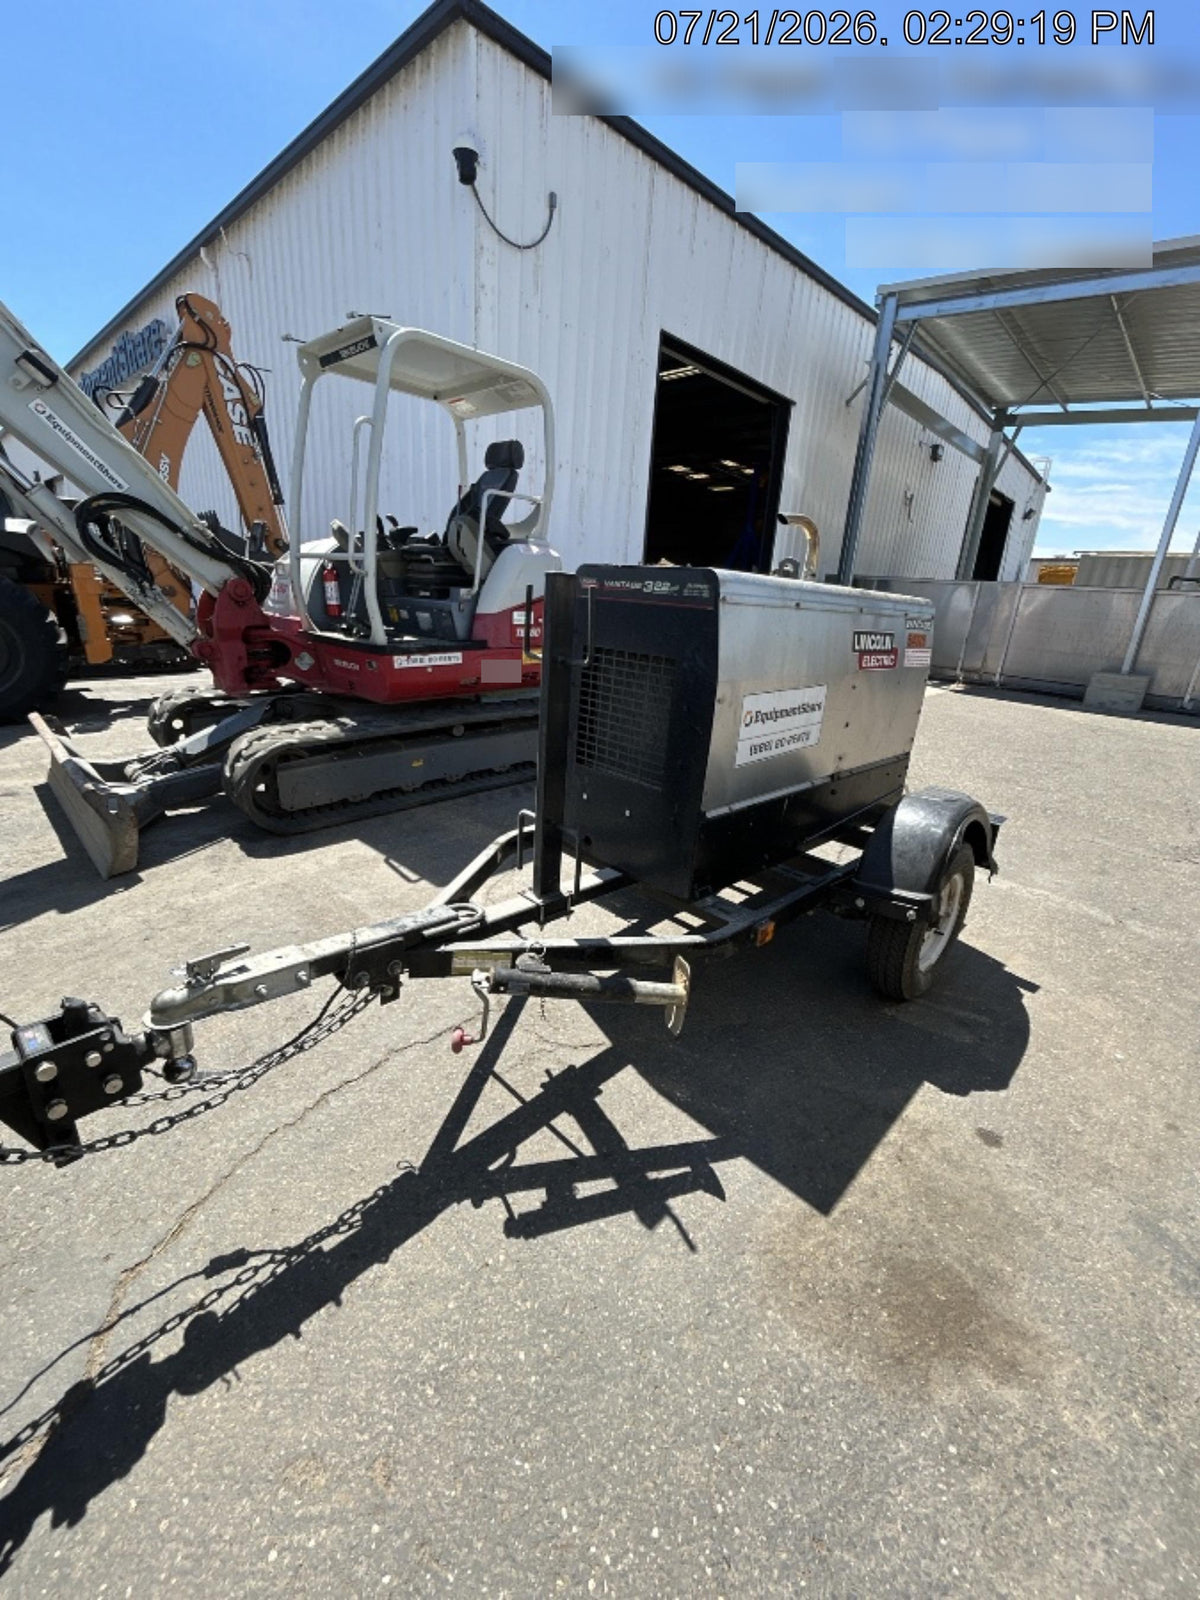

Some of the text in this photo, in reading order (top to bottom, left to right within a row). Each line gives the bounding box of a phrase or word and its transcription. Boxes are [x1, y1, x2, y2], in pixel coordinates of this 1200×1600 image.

[213, 351, 254, 447] CASE
[45, 414, 125, 490] EquipmentShare
[854, 633, 892, 650] LINCOLN
[861, 654, 896, 668] ELECTRIC
[754, 702, 822, 725] EquipmentShare
